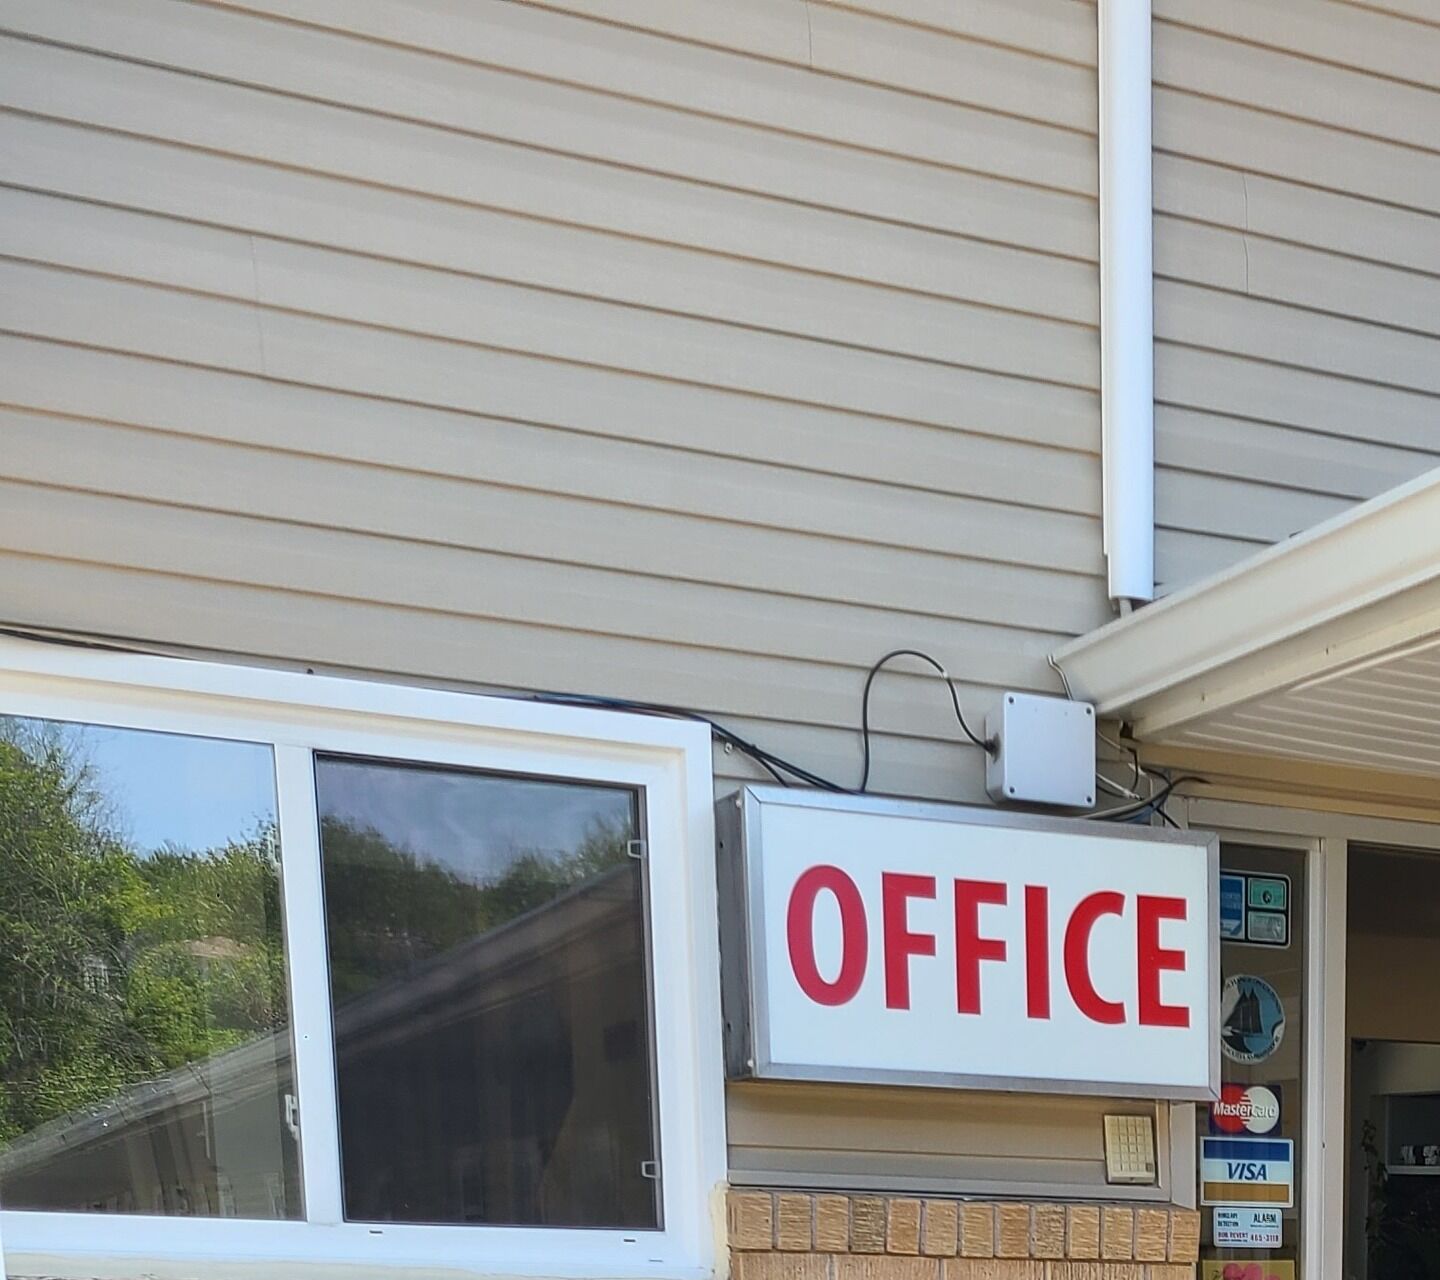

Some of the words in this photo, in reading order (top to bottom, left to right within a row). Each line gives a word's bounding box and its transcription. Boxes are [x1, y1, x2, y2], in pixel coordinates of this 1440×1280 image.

[786, 863, 1190, 1028] OFFICE
[1213, 1101, 1277, 1118] MasterCard
[1227, 1162, 1268, 1181] VISA
